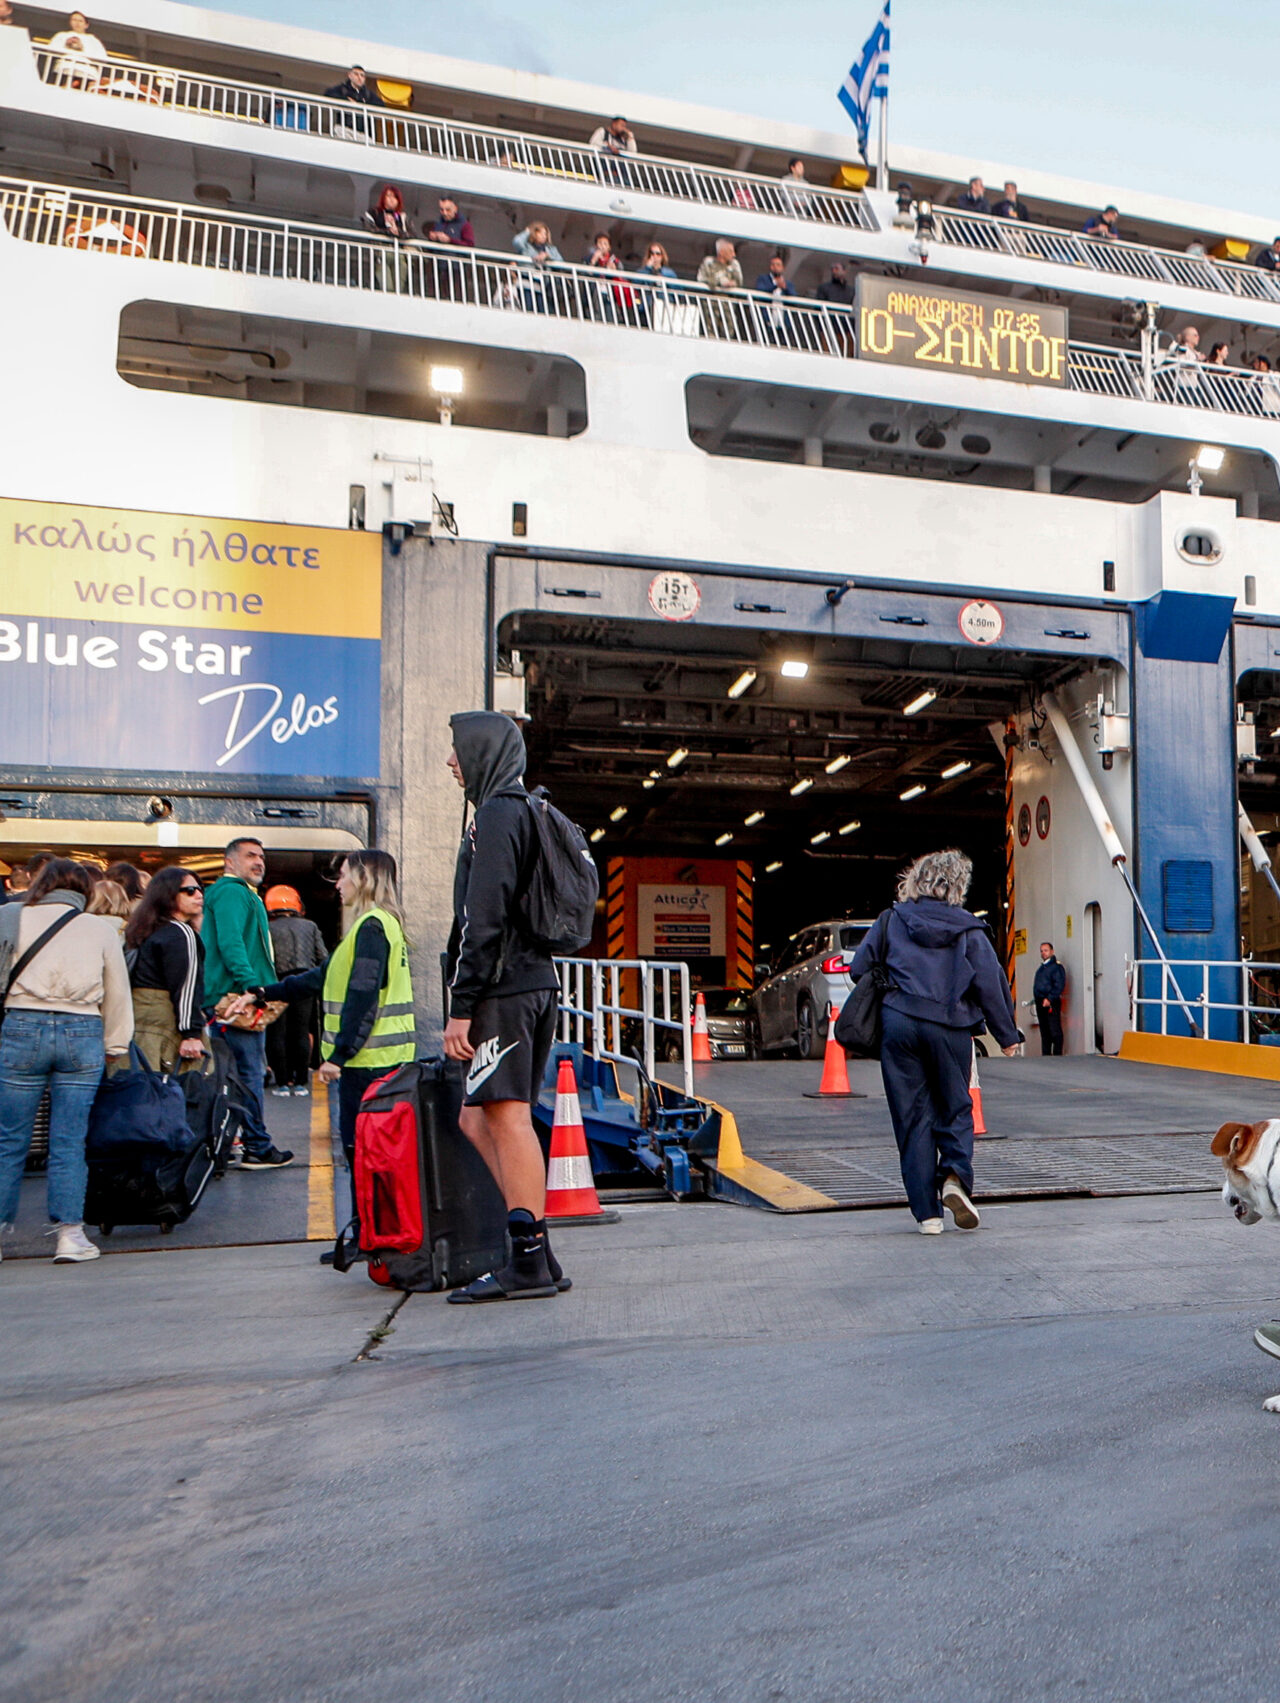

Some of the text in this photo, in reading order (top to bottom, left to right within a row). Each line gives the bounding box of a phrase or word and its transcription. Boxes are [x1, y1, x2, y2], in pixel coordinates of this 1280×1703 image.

[887, 291, 1040, 335] ΑΝΑΧΩΡΗΣΗ 07:25
[13, 518, 321, 570] καλώς ήλθατε
[74, 576, 264, 615] welcome
[968, 617, 996, 628] 4.50m
[0, 620, 252, 677] Blue Star
[198, 682, 339, 767] Delos
[654, 894, 698, 905] Attica
